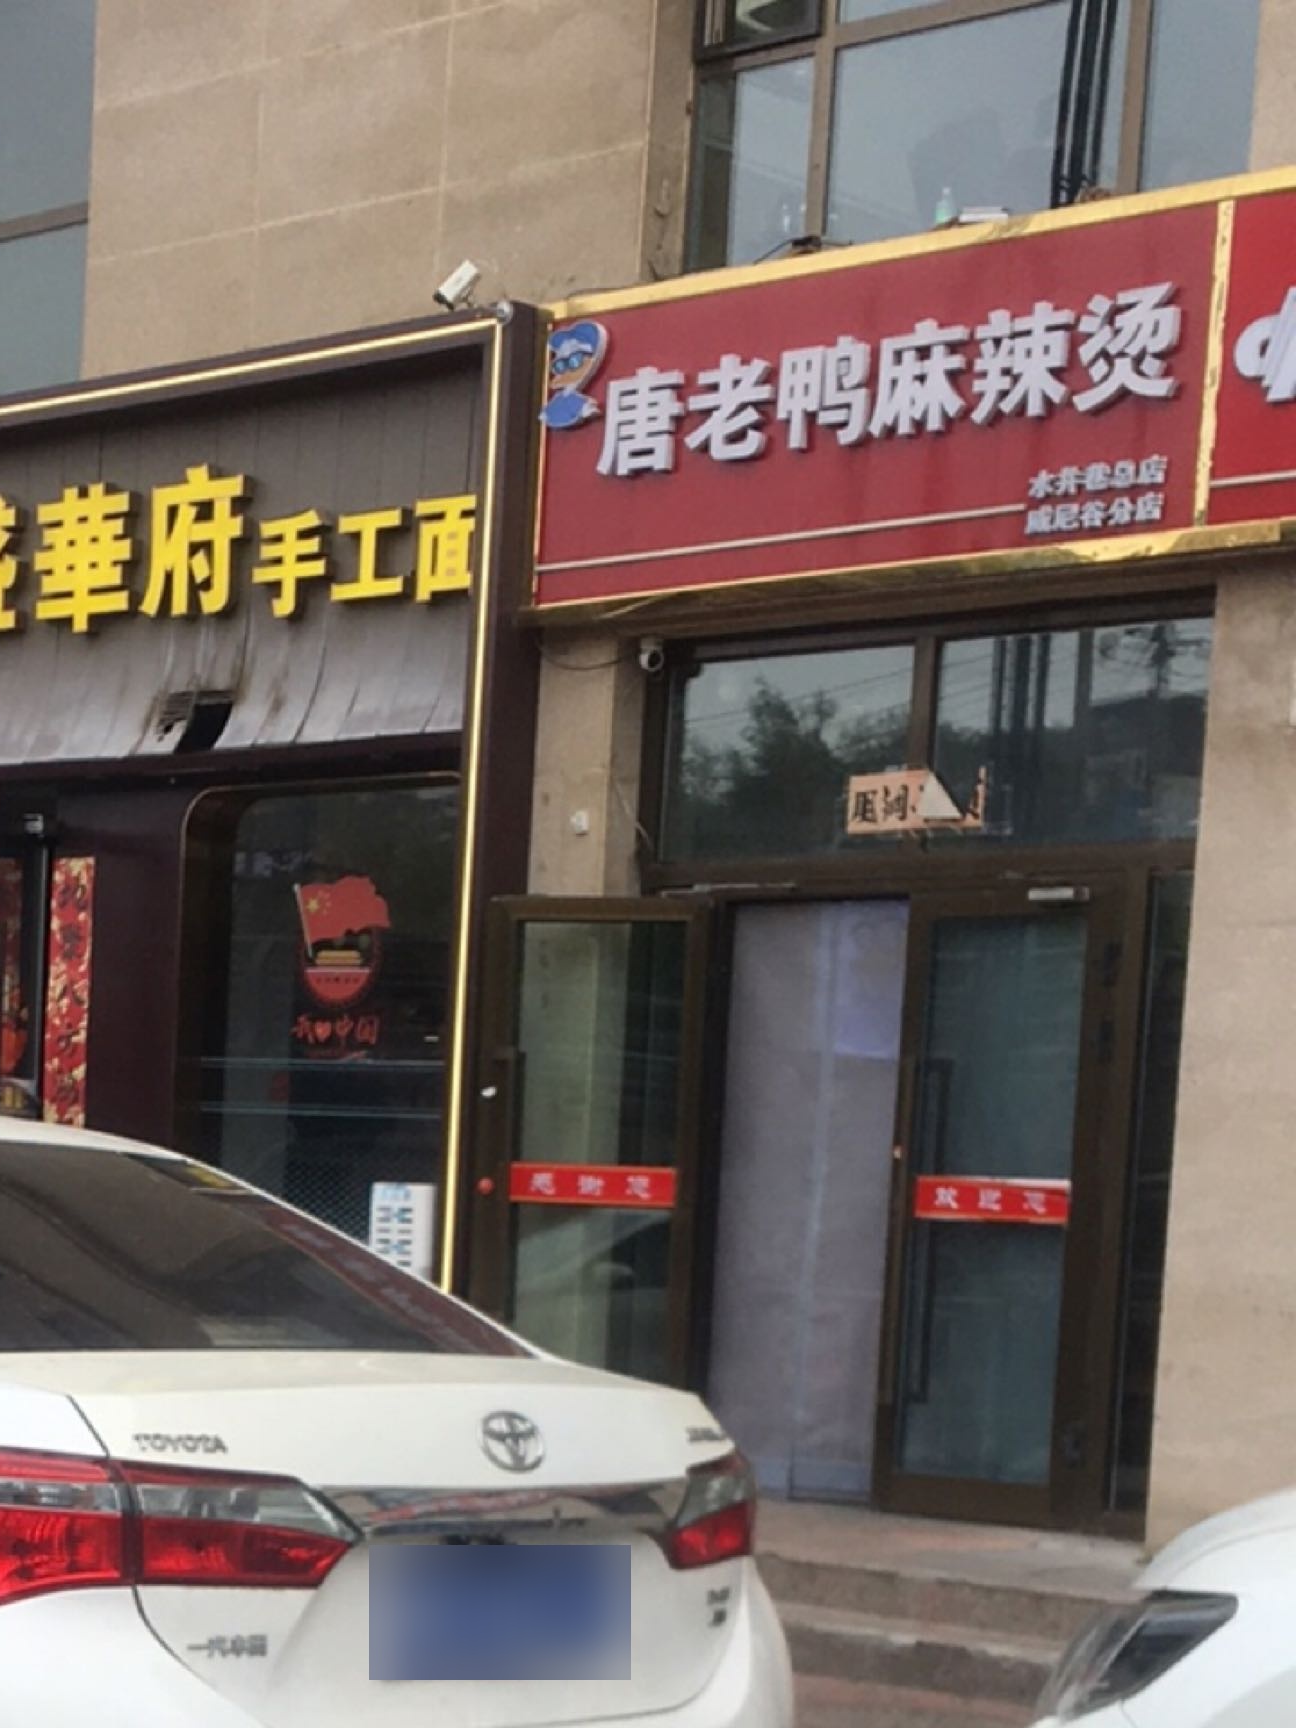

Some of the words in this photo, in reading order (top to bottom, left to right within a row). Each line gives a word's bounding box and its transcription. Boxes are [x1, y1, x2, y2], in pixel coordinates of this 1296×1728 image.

[595, 281, 1182, 479] 唐老鸭麻辣烫
[1028, 454, 1168, 499] 水井巷总店
[133, 1432, 229, 1454] TOYOTA
